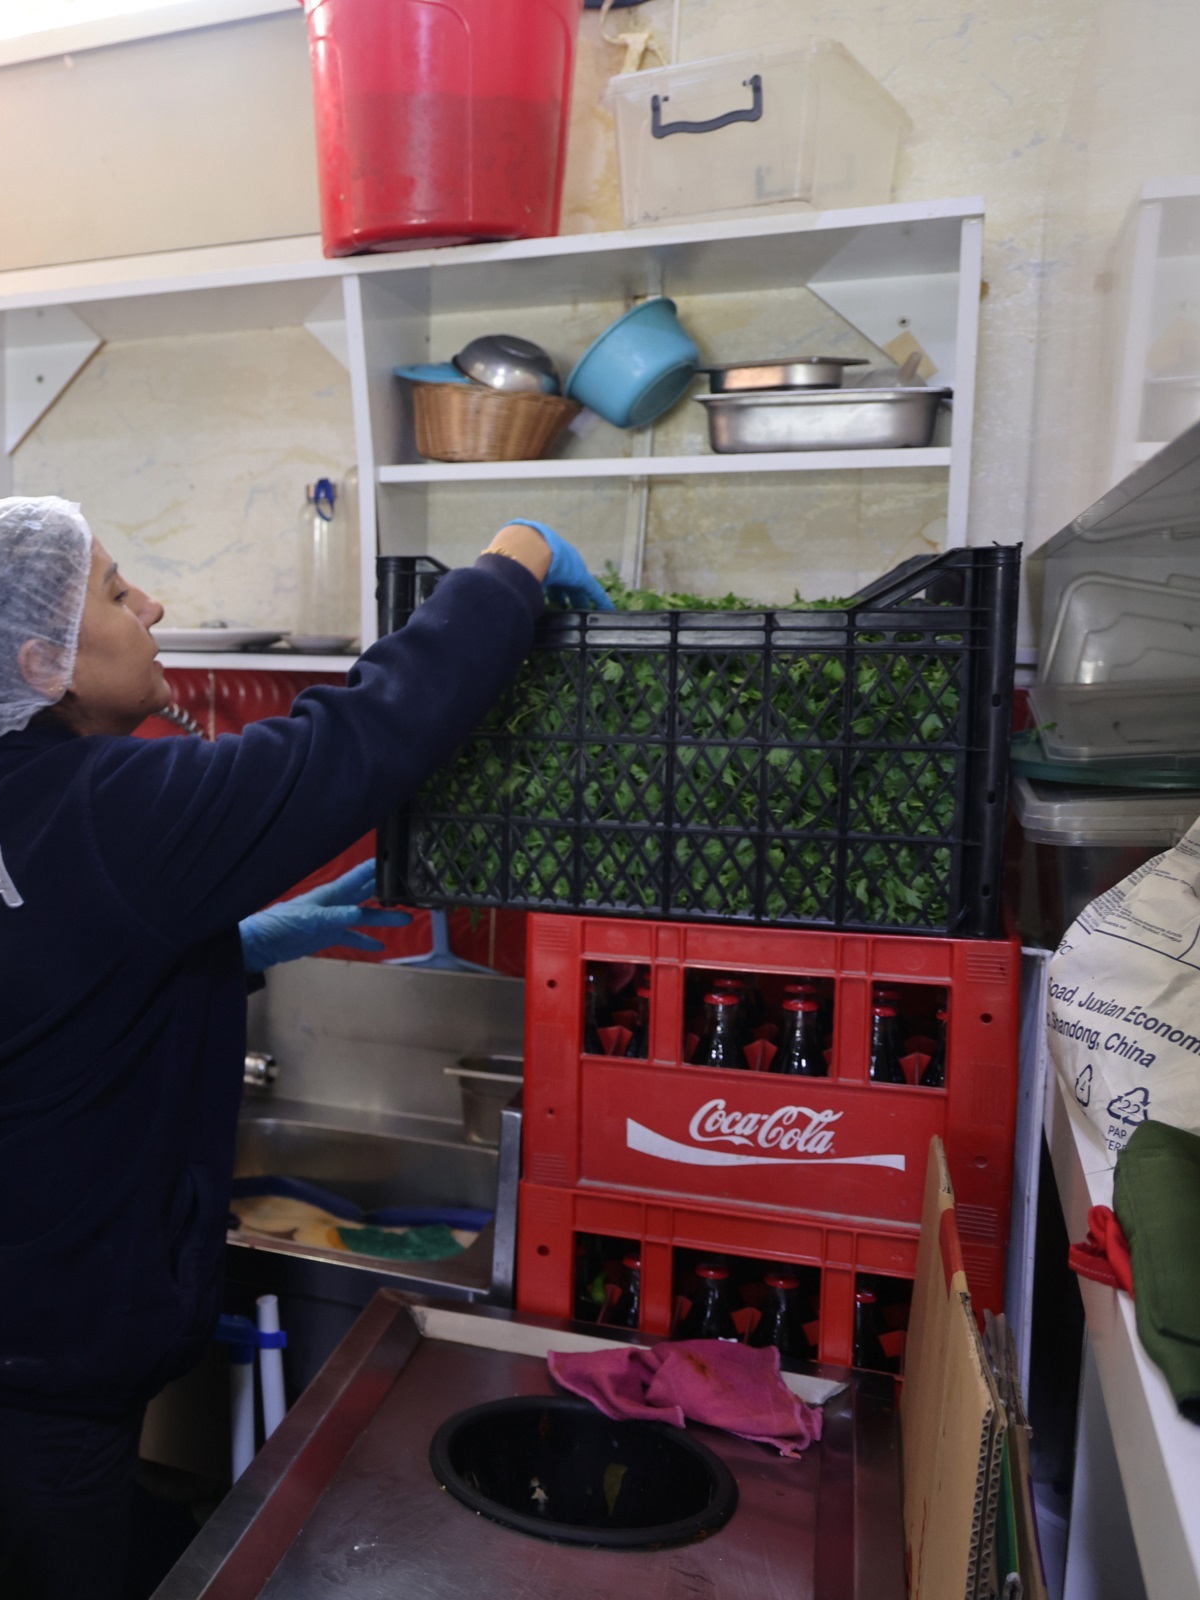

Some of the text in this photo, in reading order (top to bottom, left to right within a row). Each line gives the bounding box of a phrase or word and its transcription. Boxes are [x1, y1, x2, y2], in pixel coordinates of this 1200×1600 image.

[1077, 991, 1127, 1020] Juxian
[1051, 1011, 1156, 1069] Sandong, China
[1117, 1099, 1141, 1117] 22
[688, 1098, 844, 1155] Coca-Cola
[1107, 1124, 1128, 1140] PAP
